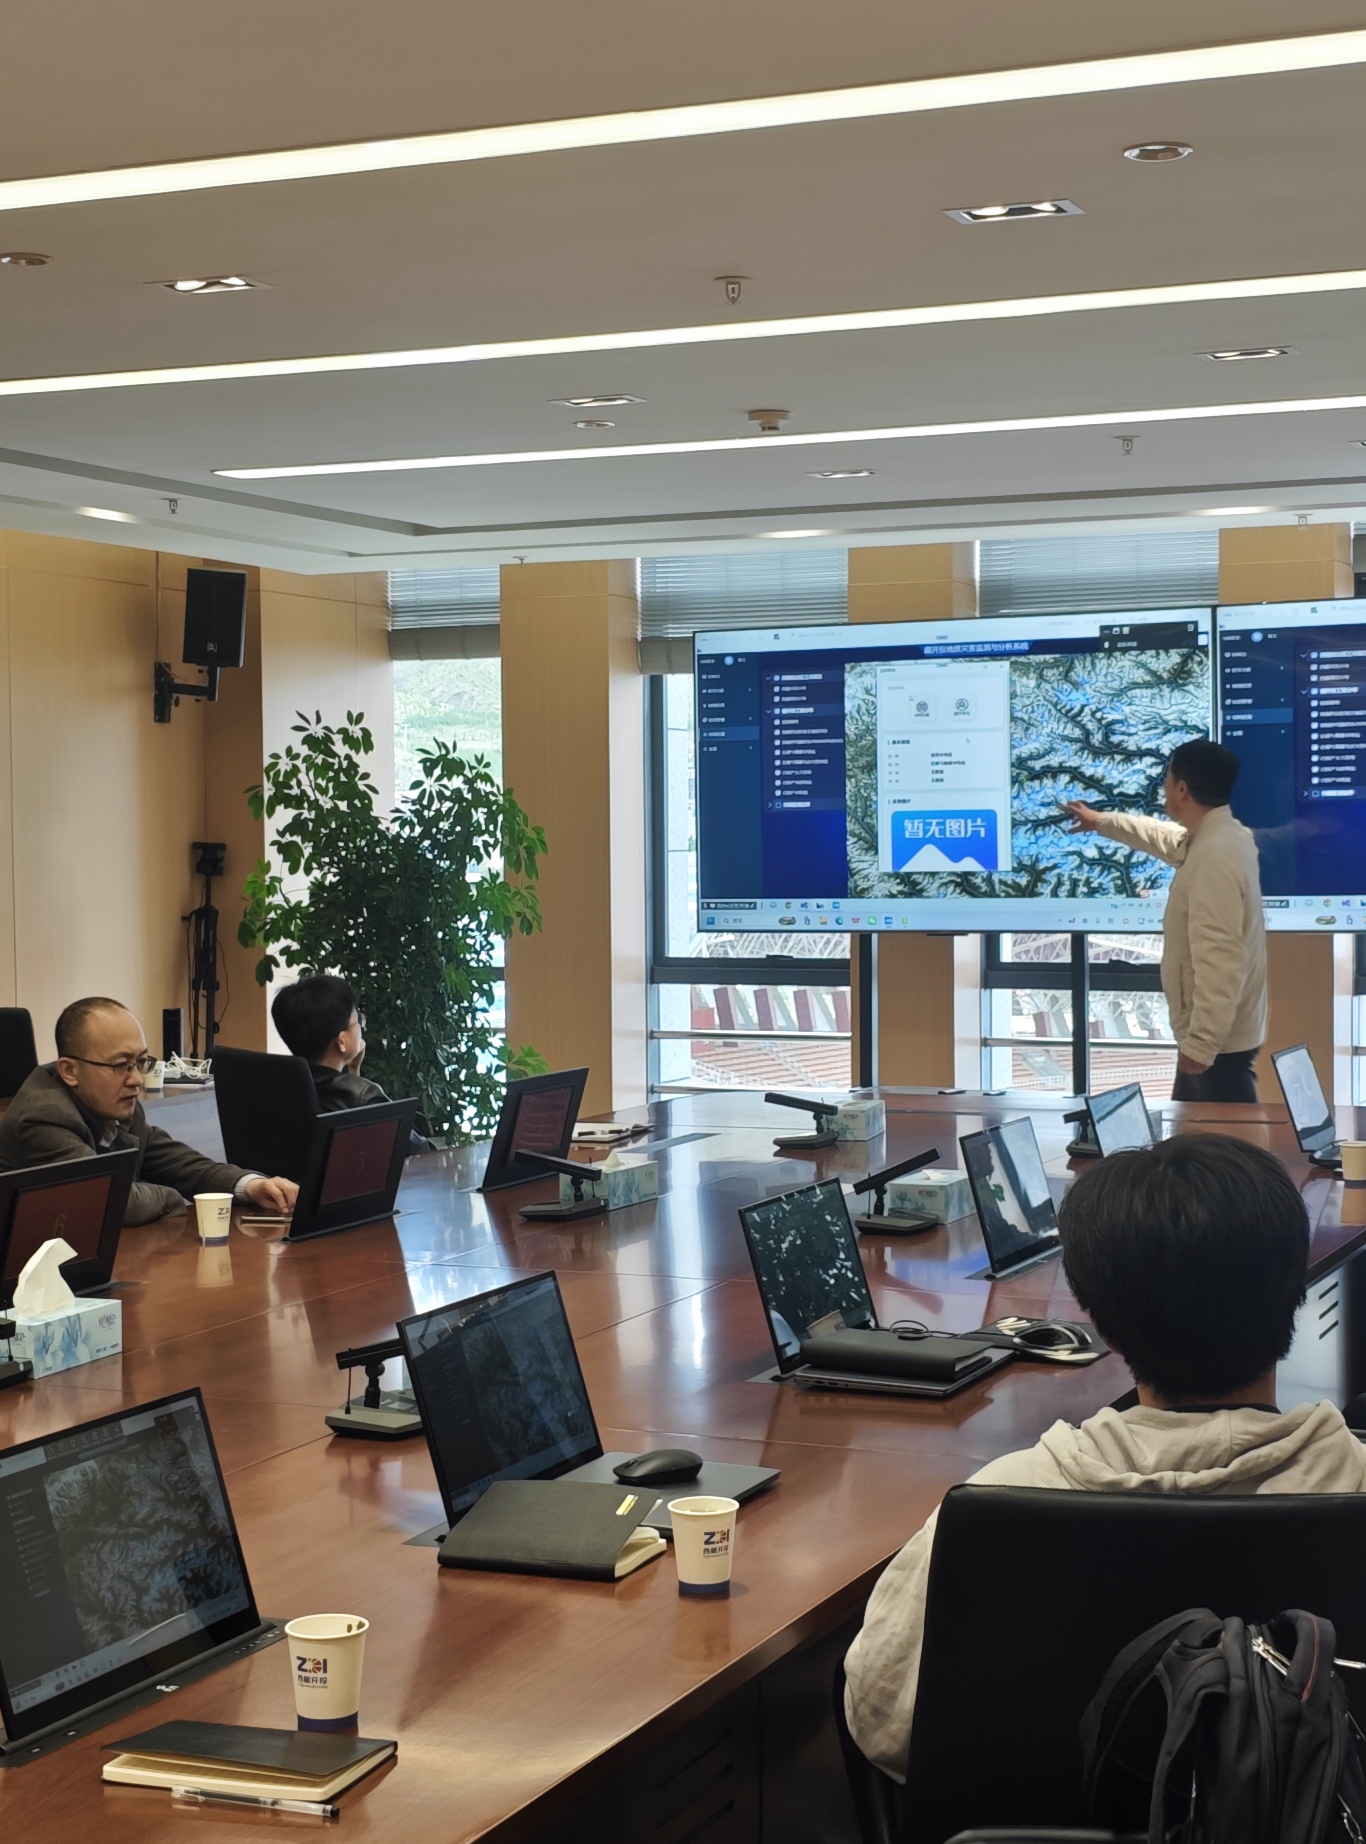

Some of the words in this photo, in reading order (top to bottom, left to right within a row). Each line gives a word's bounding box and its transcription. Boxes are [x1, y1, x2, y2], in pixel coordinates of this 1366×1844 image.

[903, 817, 987, 839] 暂无图片
[53, 1213, 67, 1237] 6
